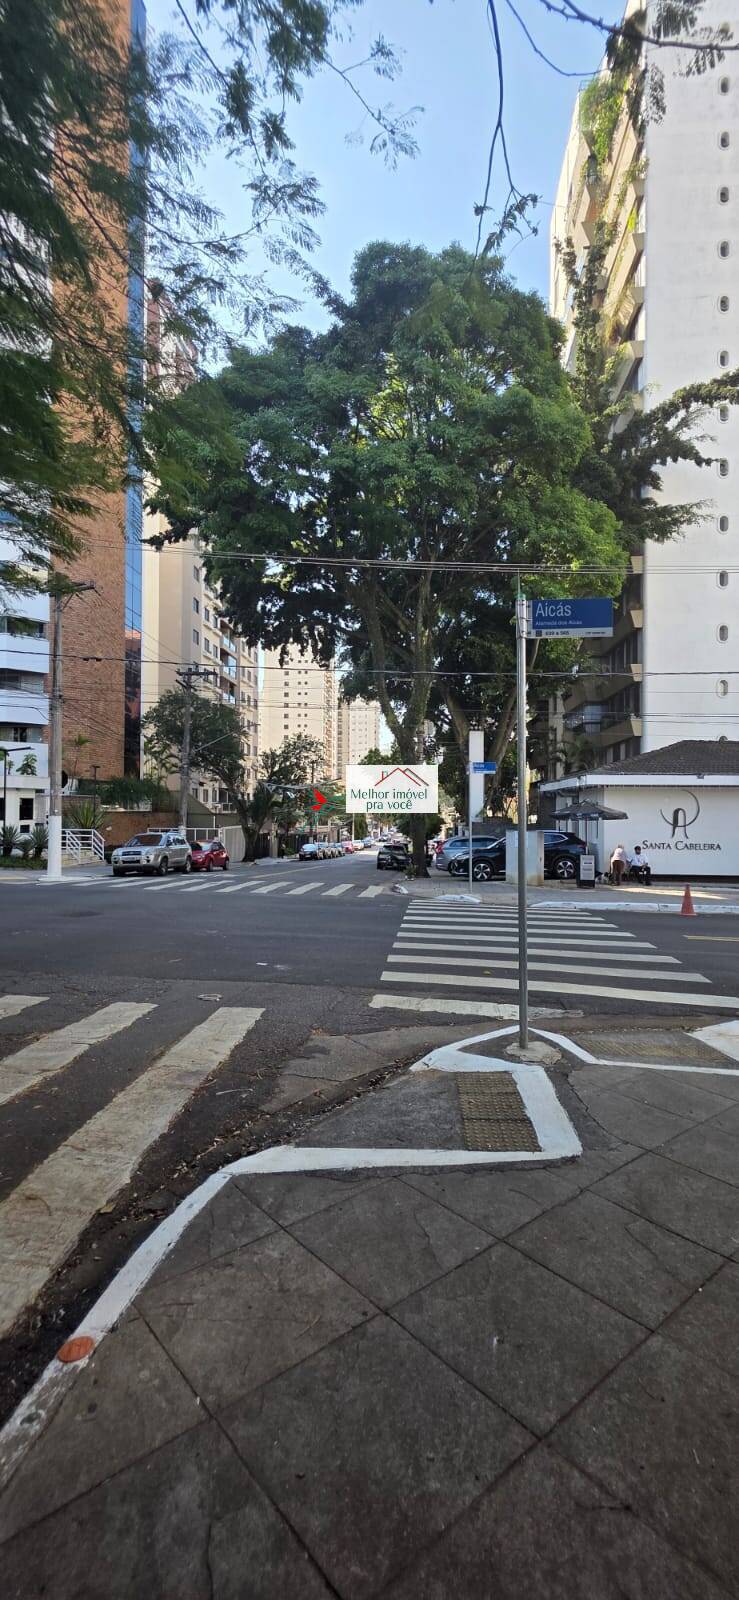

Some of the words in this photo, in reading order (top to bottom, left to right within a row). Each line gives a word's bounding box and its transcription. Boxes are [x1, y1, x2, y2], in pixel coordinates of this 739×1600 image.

[535, 602, 572, 617] Aicás
[642, 839, 672, 850] SANTA
[674, 840, 722, 851] CABELEIRA
